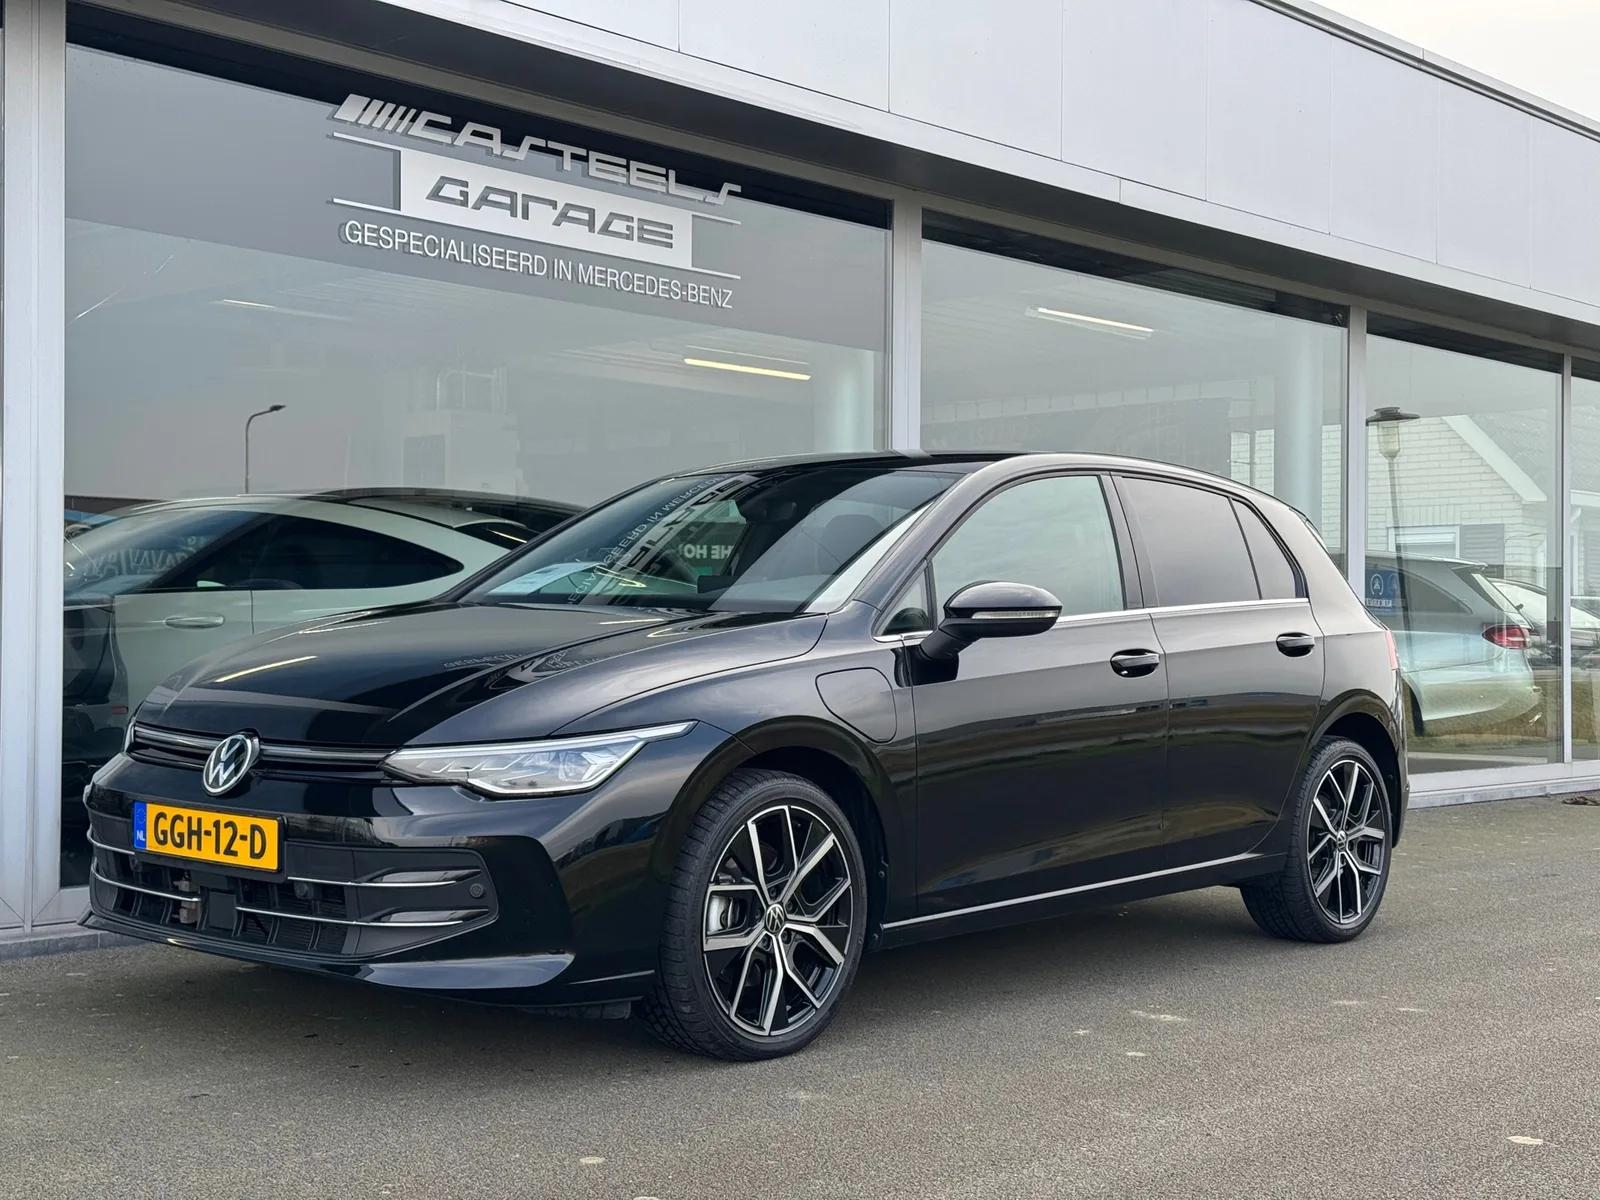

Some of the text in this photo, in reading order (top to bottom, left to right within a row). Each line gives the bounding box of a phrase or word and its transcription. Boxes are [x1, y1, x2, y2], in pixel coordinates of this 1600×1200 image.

[407, 110, 742, 206] CASTEELS
[425, 175, 674, 249] GARAGE
[344, 220, 733, 308] GESPECIALISEERD IN MERCEDES-BENZ
[136, 829, 146, 842] NL
[153, 811, 267, 860] GGH-12-D
